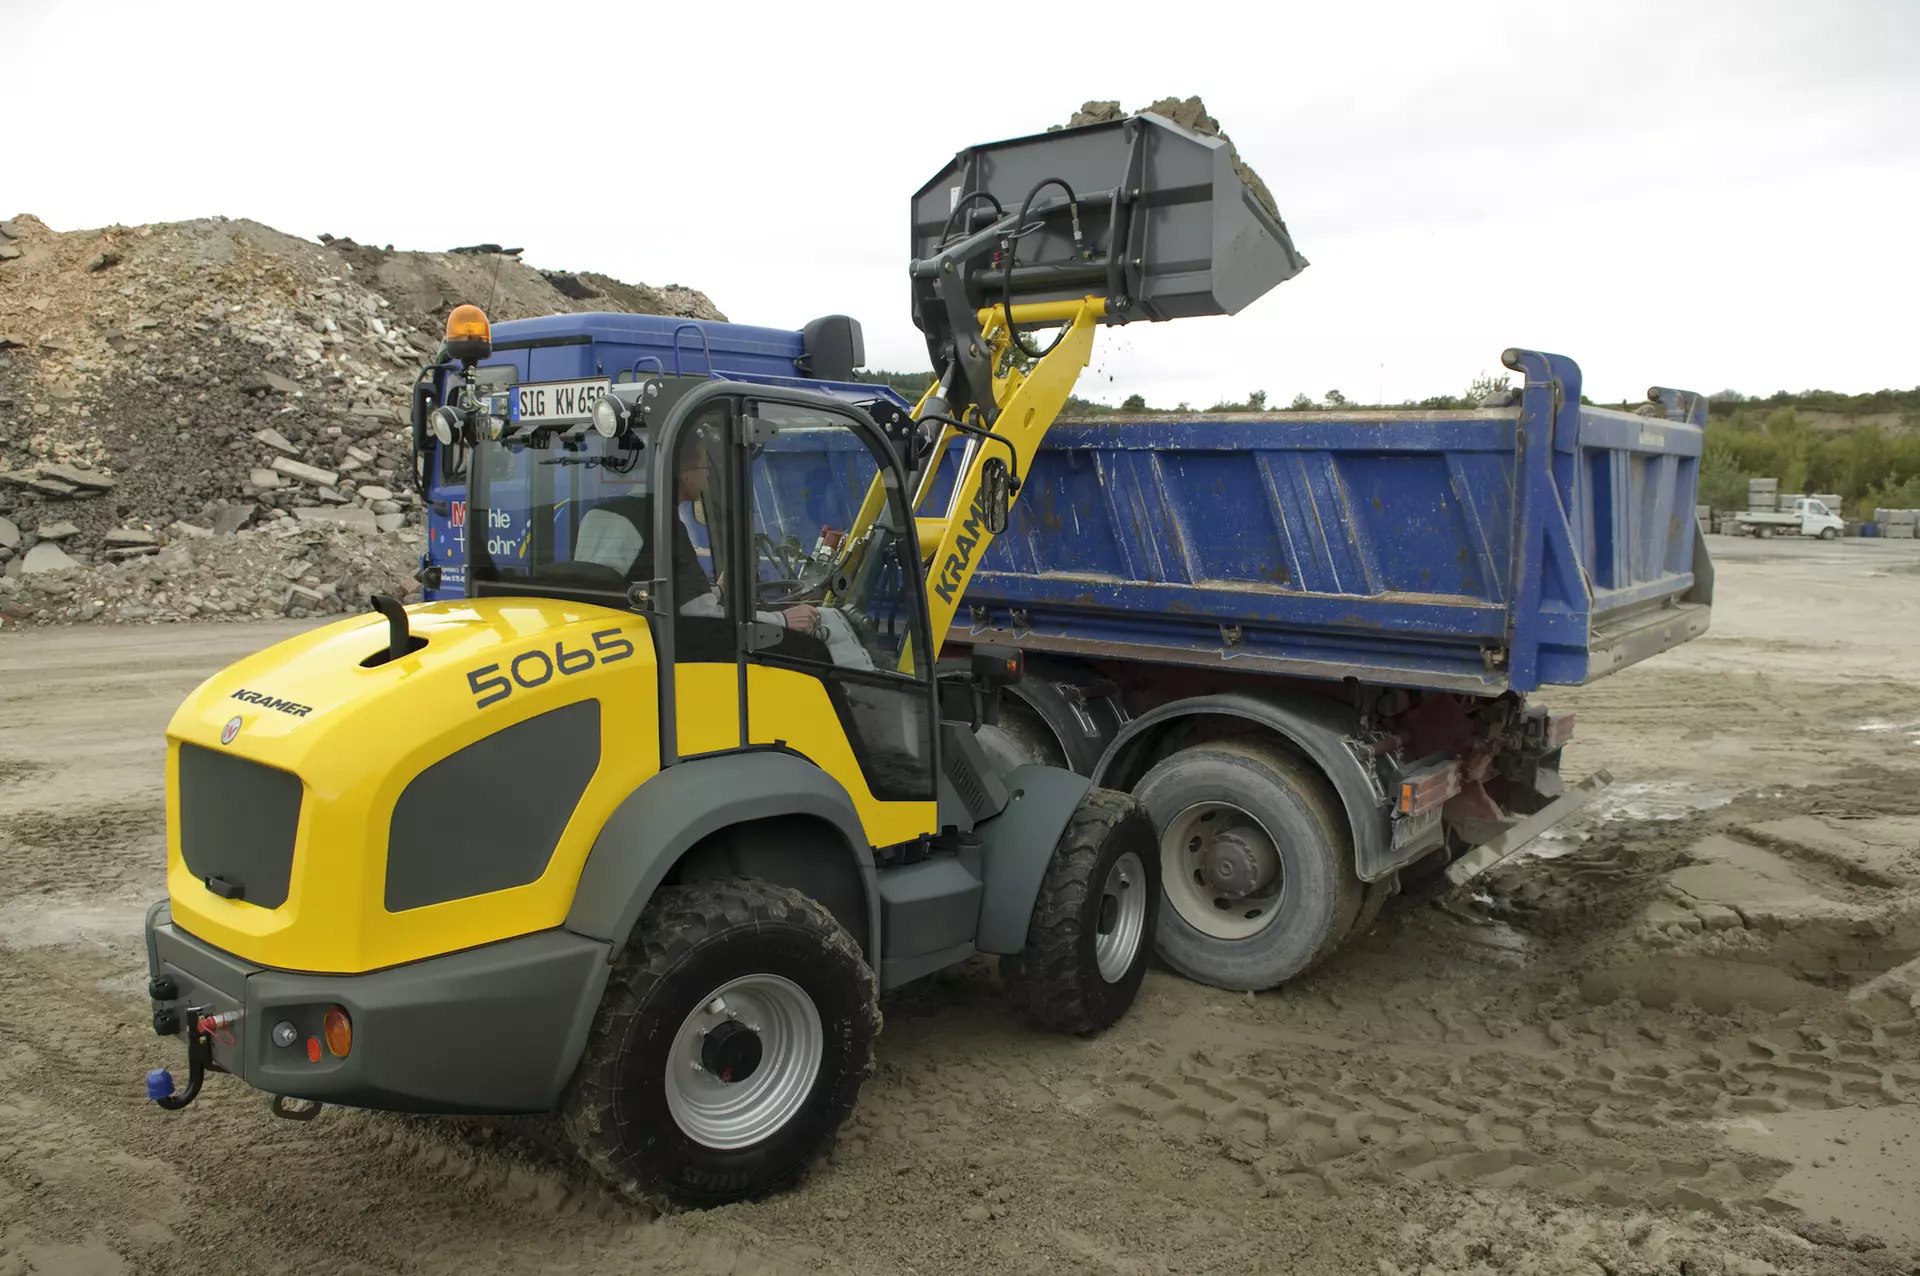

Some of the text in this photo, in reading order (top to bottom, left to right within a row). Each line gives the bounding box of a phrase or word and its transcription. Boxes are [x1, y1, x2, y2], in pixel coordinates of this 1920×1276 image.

[520, 390, 545, 416] SIG
[556, 387, 574, 415] KW
[934, 486, 983, 605] KRAM
[467, 627, 635, 710] 5065
[231, 689, 313, 717] KRAMER
